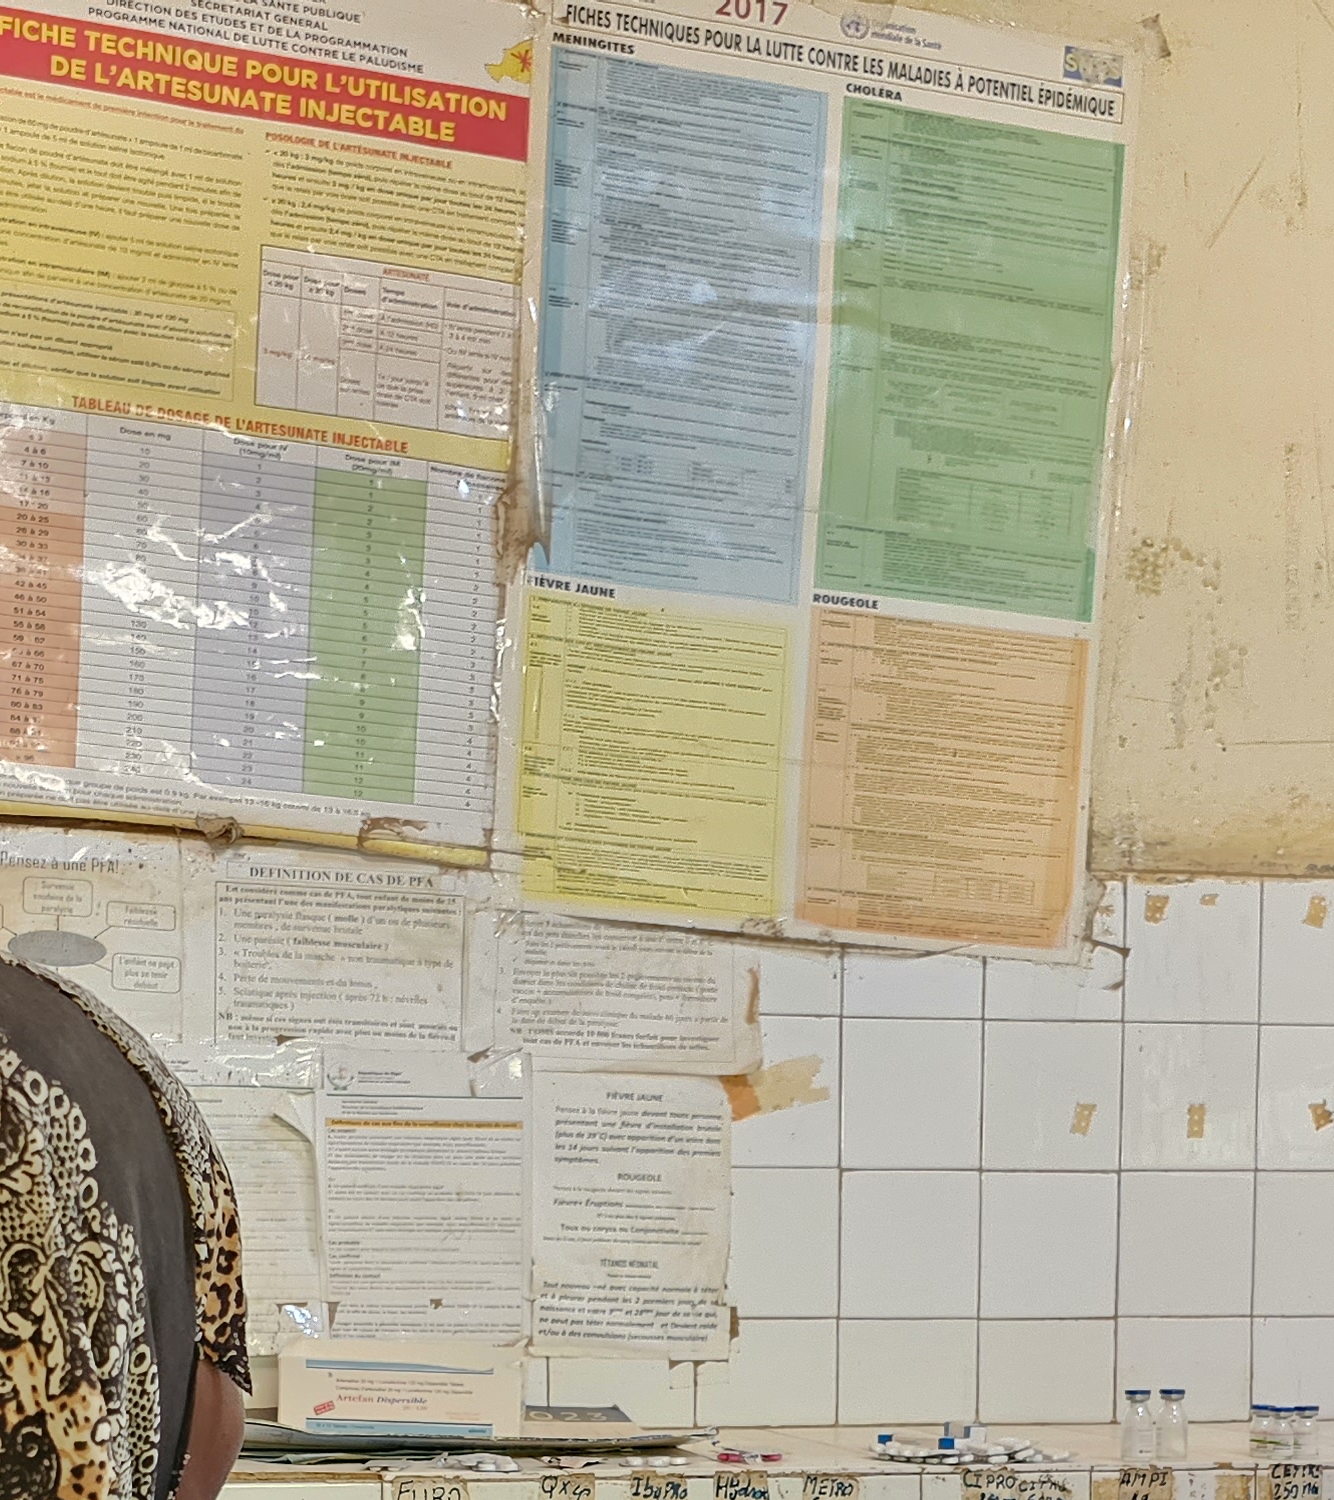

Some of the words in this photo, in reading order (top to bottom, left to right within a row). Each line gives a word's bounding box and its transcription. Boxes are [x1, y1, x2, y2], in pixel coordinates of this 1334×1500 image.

[190, 0, 271, 21] SECRETARIAT
[274, 14, 329, 31] GENERAL
[303, 6, 362, 24] PUBLIQUE
[715, 0, 788, 26] 2017
[106, 0, 172, 16] DIRECTION
[175, 9, 198, 21] DES
[202, 13, 246, 29] ETUDES
[250, 22, 264, 33] ET
[267, 26, 283, 37] DE
[286, 29, 301, 40] LA
[305, 33, 408, 57] PROGRAMMATION
[88, 7, 166, 29] PROGRAMME
[169, 22, 230, 41] NATIONAL
[233, 33, 250, 44] DE
[252, 36, 288, 51] LUTTE
[291, 43, 338, 59] CONTRE
[342, 51, 356, 62] LE
[359, 54, 424, 74] PALUDISME
[552, 32, 635, 55] MENINGITES
[566, 4, 611, 29] FICHES
[617, 12, 700, 44] TECHNIQUES
[704, 25, 742, 50] POUR
[746, 35, 762, 53] LA
[767, 39, 803, 62] LUTTE
[808, 47, 859, 72] CONTRE
[863, 55, 883, 76] LES
[887, 61, 952, 89] MALADIES
[955, 67, 964, 92] À
[967, 75, 1034, 104] POTENTIEL
[1038, 80, 1115, 117] ÉPIDÉMIQUE
[84, 30, 239, 77] TECHNIQUE
[246, 60, 318, 90] POUR
[325, 72, 507, 122] L'UTILISATION
[51, 55, 87, 80] DE
[94, 62, 292, 115] L'ARTESUNATE
[300, 98, 456, 143] INJECTABLE
[266, 132, 316, 148] POSOLOGIE
[319, 138, 331, 149] DE
[400, 151, 453, 169] INJECTABLE
[72, 395, 130, 415] TABLEAU
[135, 403, 154, 418] DE
[157, 406, 211, 424] DOSAGE
[214, 415, 231, 428] DE
[236, 418, 328, 443] L'ARTESUNATE
[332, 432, 409, 453] INJECTABLE
[16, 514, 28, 523] 20
[37, 515, 50, 524] 25
[36, 582, 48, 591] 45
[528, 573, 572, 592] IÈVRE
[575, 583, 616, 599] JAUNE
[813, 593, 879, 611] ROUGEOLE
[0, 851, 47, 870] Pensez
[51, 856, 60, 871] à
[63, 858, 87, 872] une
[249, 867, 332, 882] DEFINITION
[335, 871, 354, 884] DE
[356, 872, 384, 886] CAS
[386, 874, 406, 887] DE
[409, 876, 434, 889] PFA
[606, 1091, 635, 1102] FIÈVRE
[636, 1093, 664, 1103] JAUNE
[617, 1172, 662, 1182] ROUGEOLE
[803, 1475, 855, 1497] METRO
[963, 1469, 1019, 1489] CIPRO
[1274, 1481, 1299, 1500] 250
